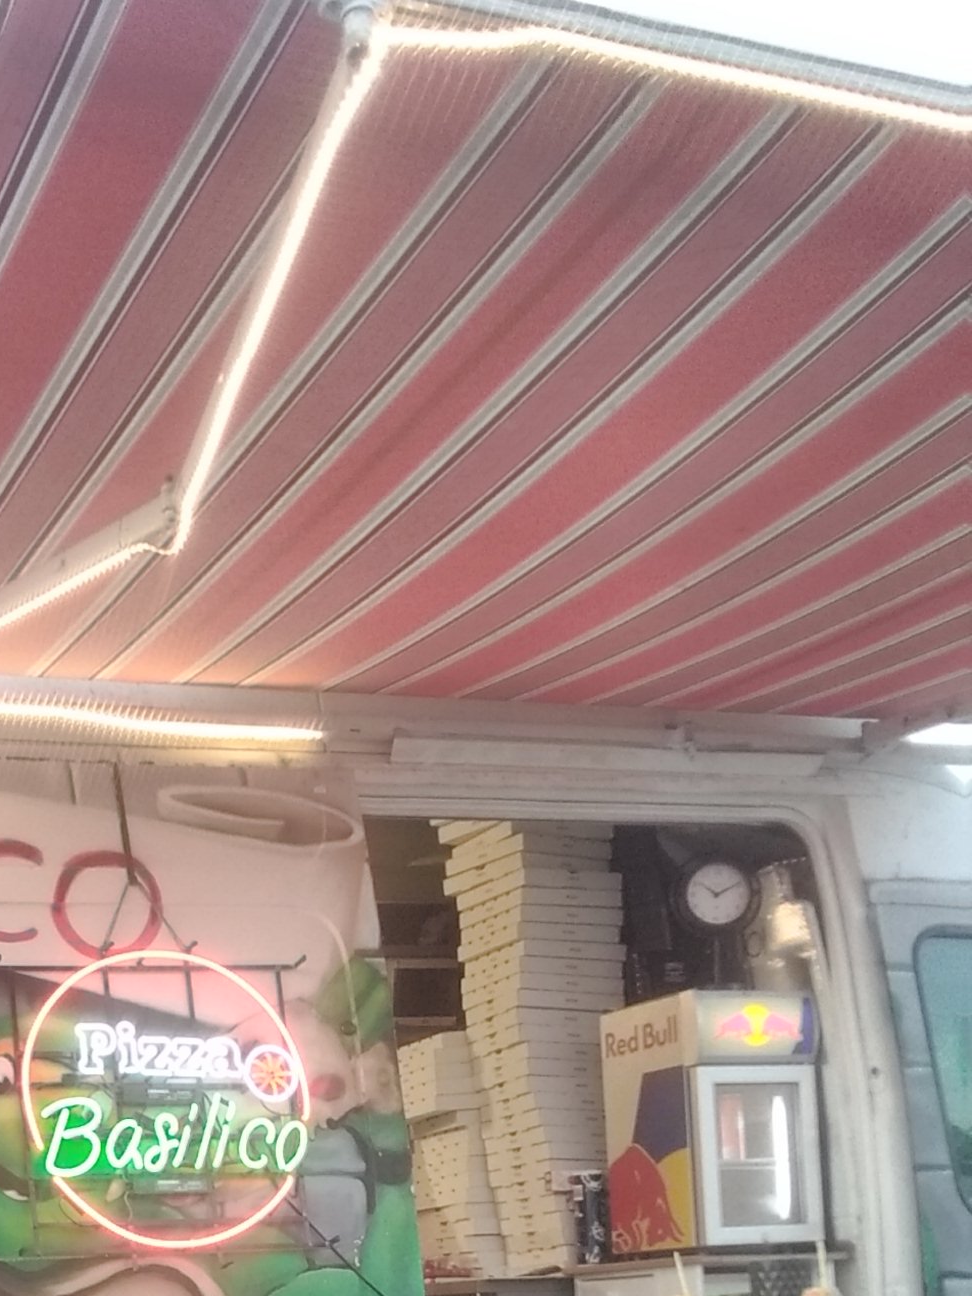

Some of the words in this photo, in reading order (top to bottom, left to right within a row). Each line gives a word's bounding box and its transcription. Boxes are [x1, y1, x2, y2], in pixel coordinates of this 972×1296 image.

[74, 1020, 245, 1077] Pizza
[605, 1024, 638, 1058] Red
[643, 1014, 678, 1050] Bull
[41, 1092, 309, 1177] Basilico
